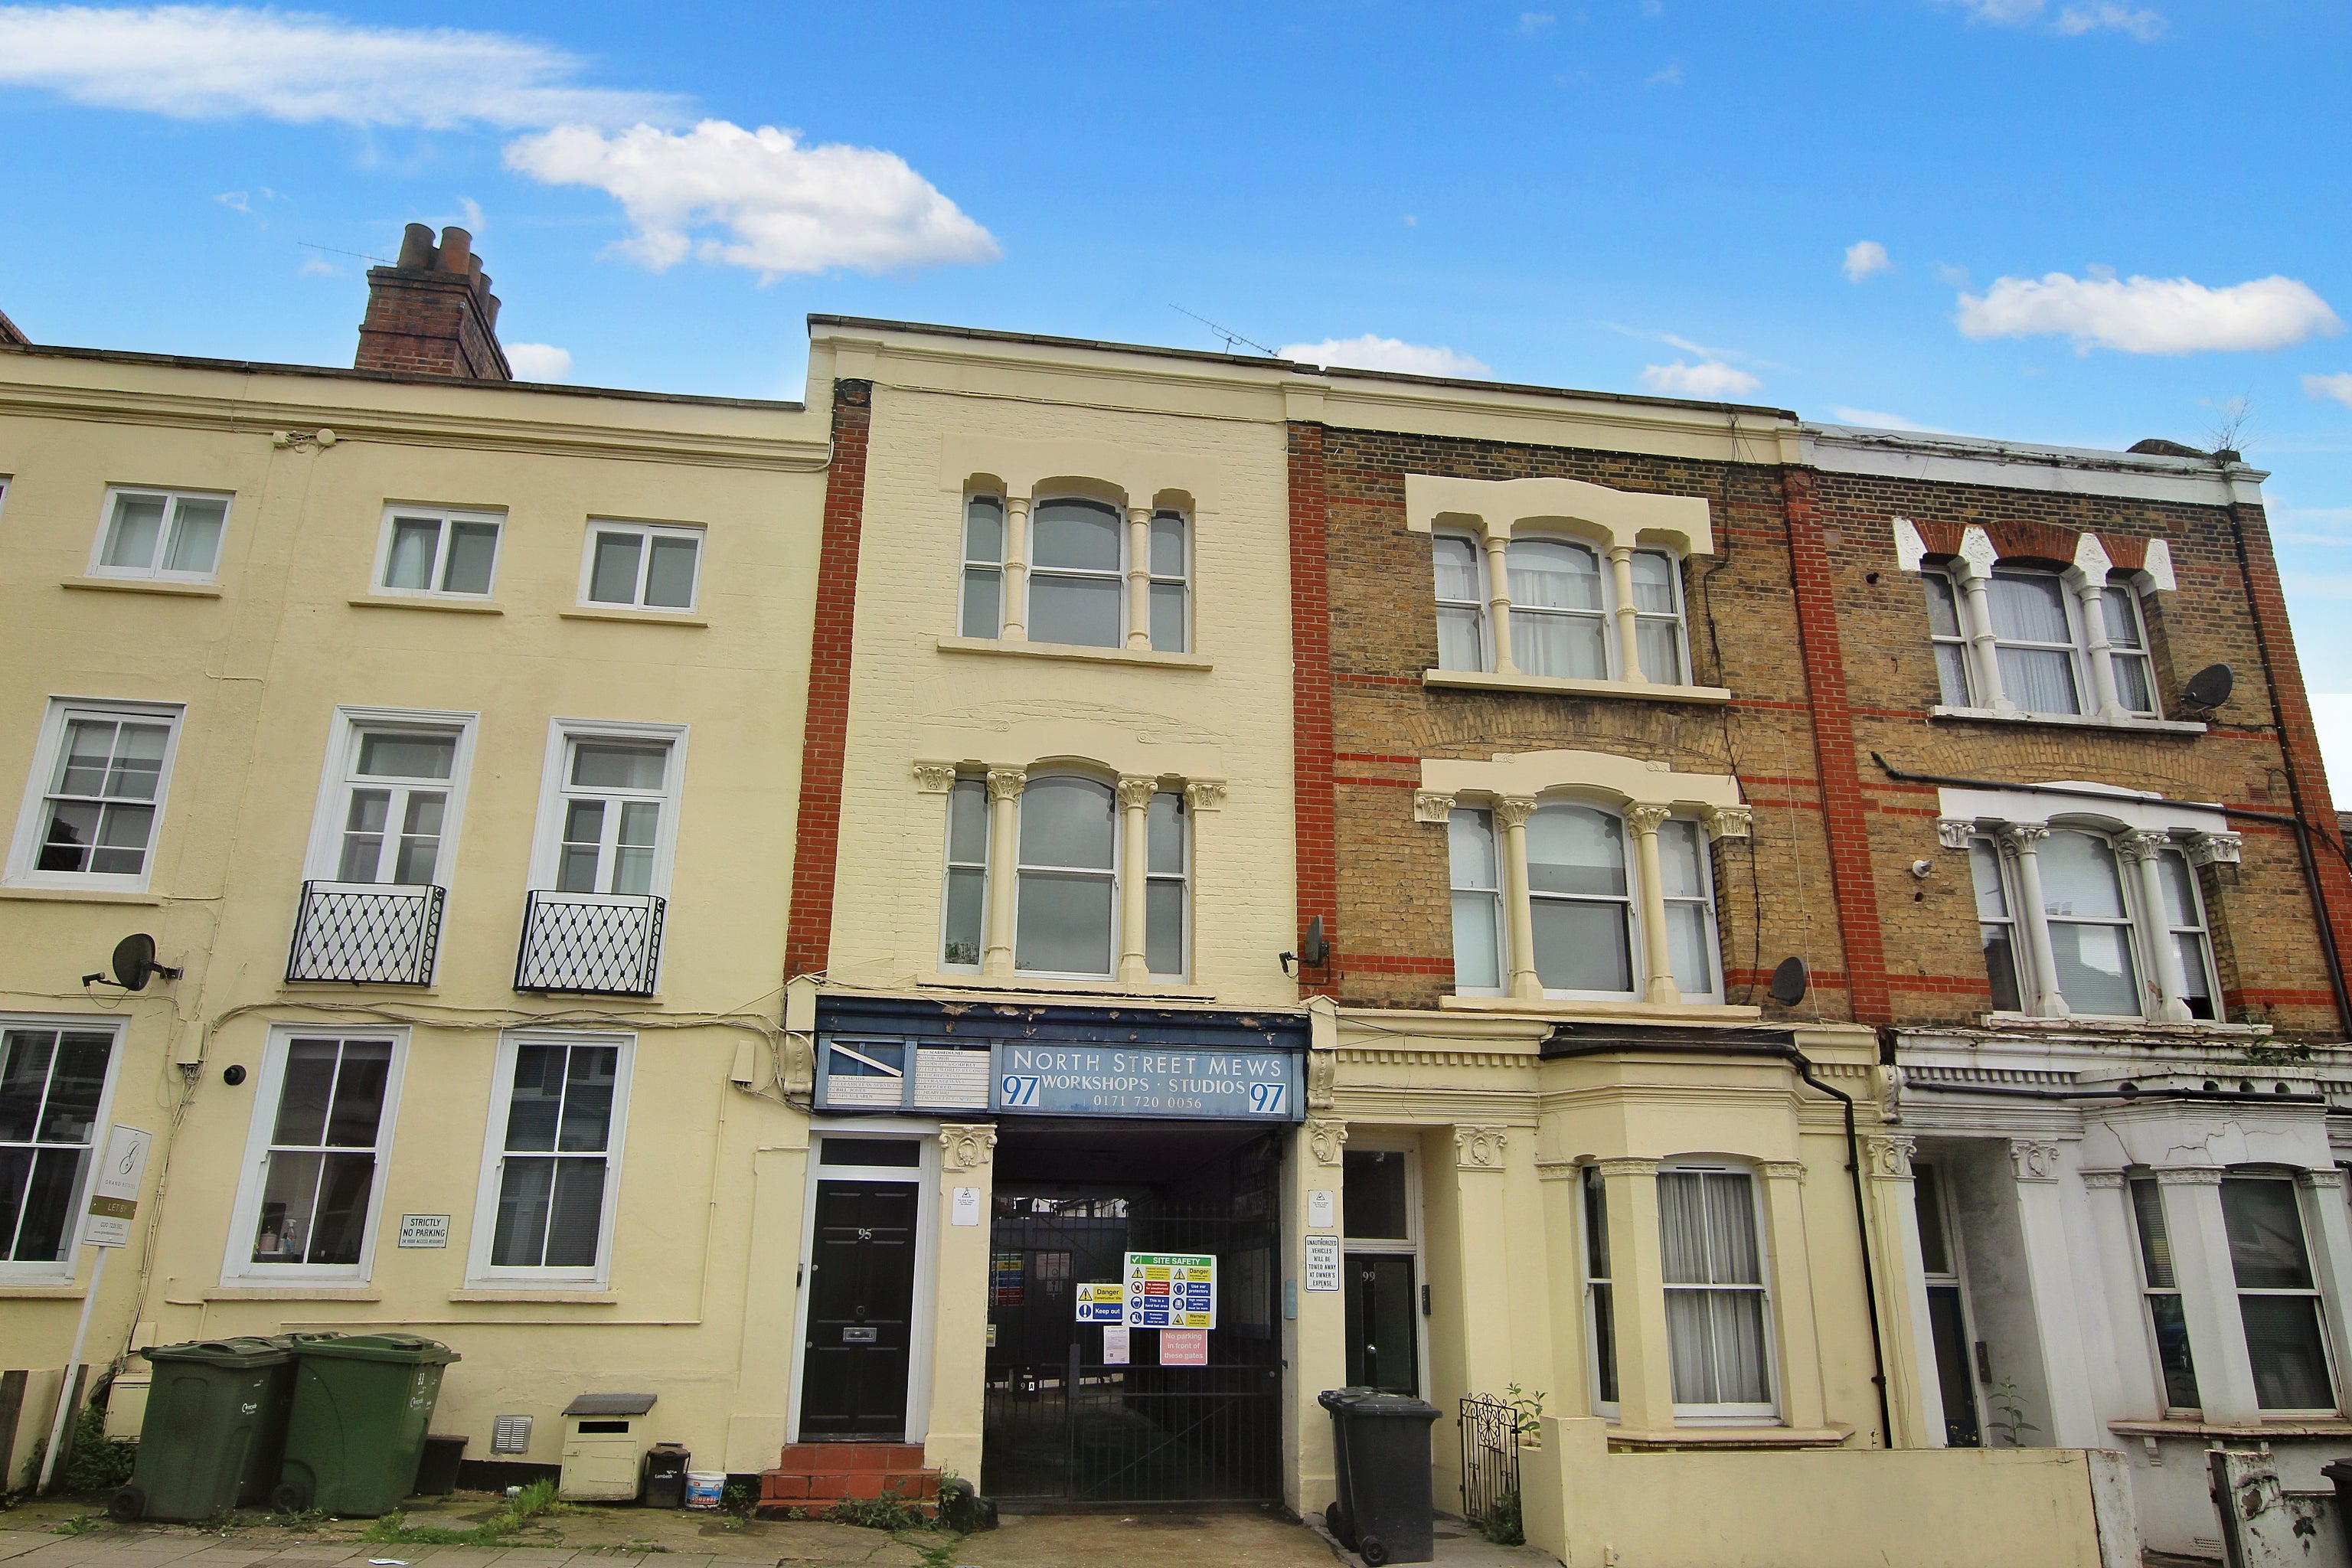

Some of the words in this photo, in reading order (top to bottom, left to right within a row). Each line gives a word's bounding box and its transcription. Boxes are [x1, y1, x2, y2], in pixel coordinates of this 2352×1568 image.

[1014, 1050, 1099, 1071] NORTH
[1112, 1053, 1196, 1074] STREET
[1208, 1057, 1281, 1077] MEWS
[1041, 1074, 1148, 1092] WORKSHOPS
[1168, 1079, 1246, 1094] STUDIOS
[1002, 1076, 1039, 1105] 97
[1093, 1095, 1125, 1106] 0171
[1134, 1096, 1159, 1108] 720
[1168, 1097, 1202, 1109] 0056
[1250, 1083, 1285, 1112] 97
[104, 1179, 122, 1187] GRAND
[107, 1202, 119, 1211] LET
[410, 1218, 442, 1227] STRICTLY
[403, 1228, 413, 1237] NO
[415, 1229, 446, 1237] PARKING
[858, 1228, 872, 1240] 95
[1362, 1271, 1376, 1282] 99
[1096, 1289, 1119, 1297] Danger
[1176, 1332, 1202, 1341] parking
[1184, 1352, 1204, 1361] gates
[1020, 1382, 1026, 1390] 9
